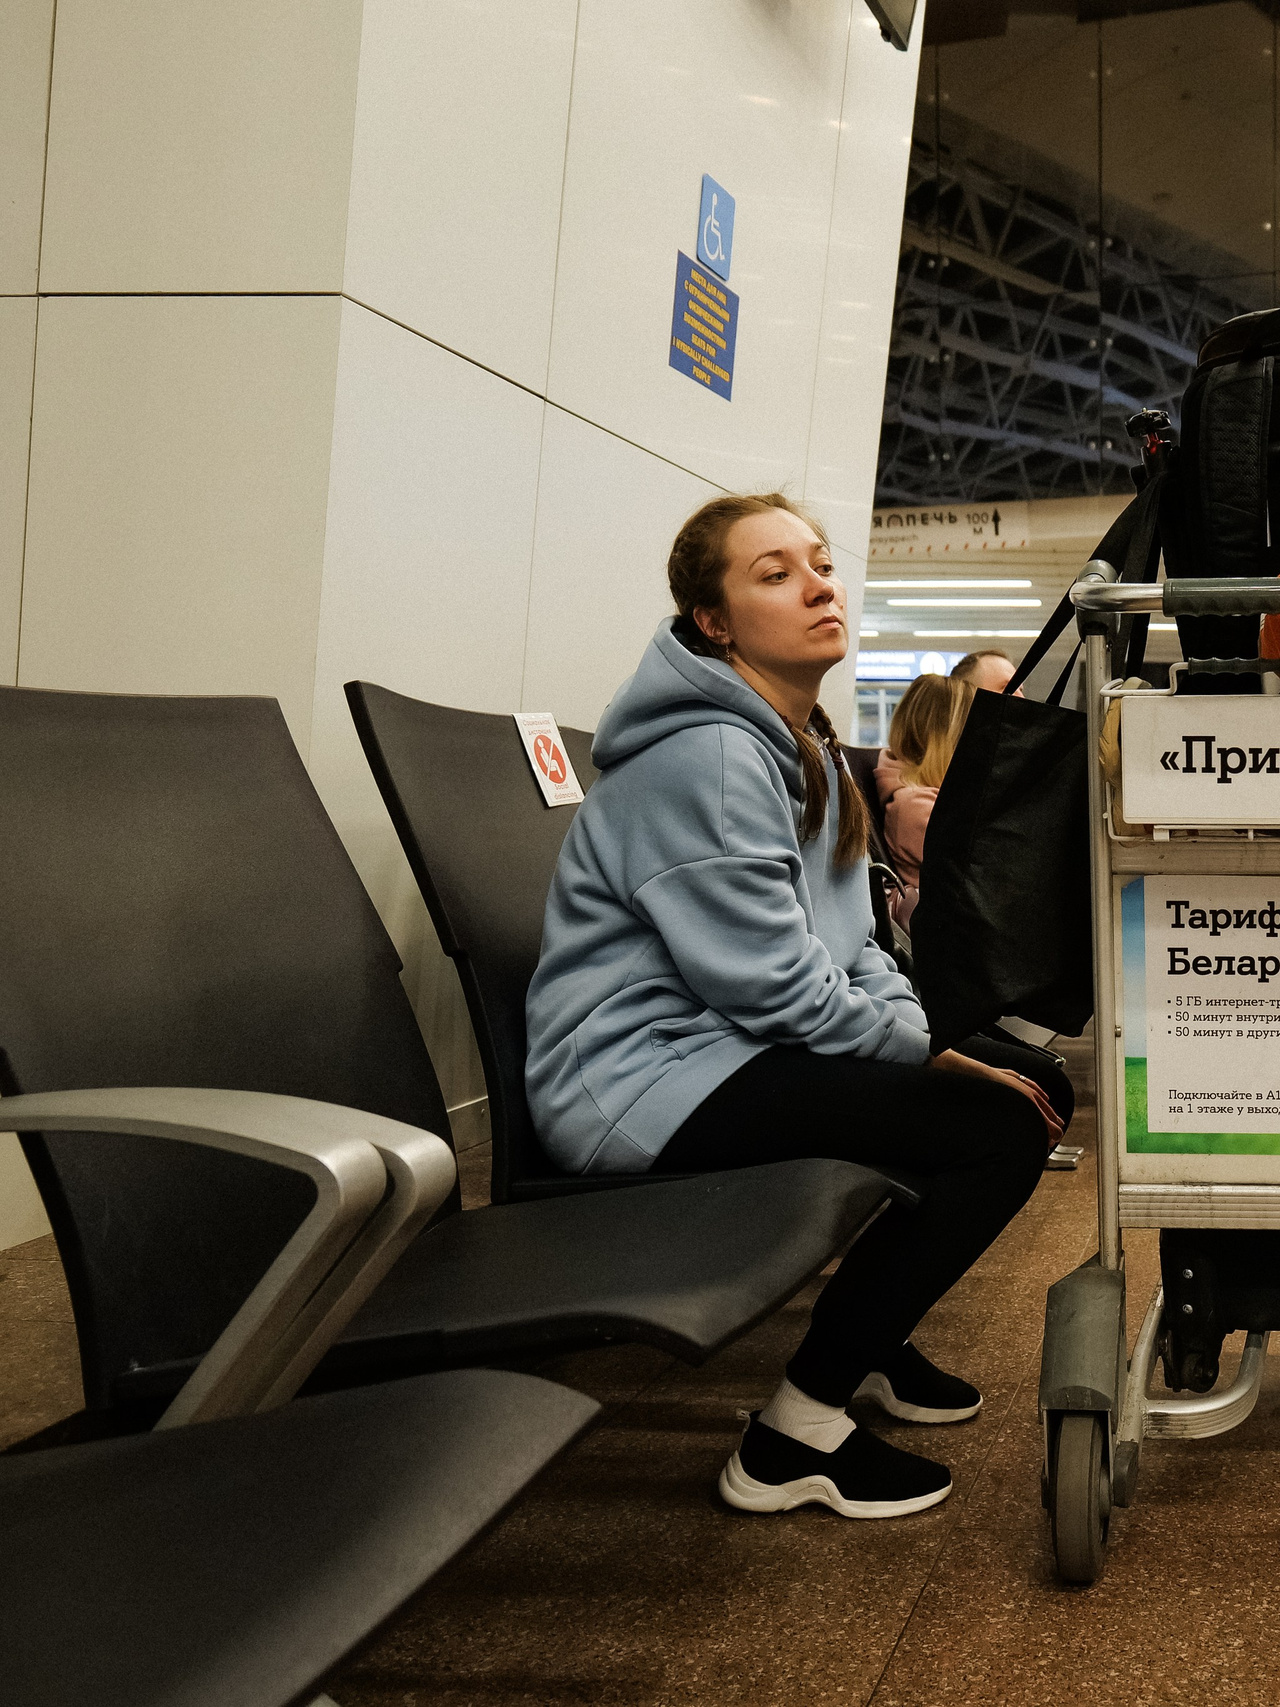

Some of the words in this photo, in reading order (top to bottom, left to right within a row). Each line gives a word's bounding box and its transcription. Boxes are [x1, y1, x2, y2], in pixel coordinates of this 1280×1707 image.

[691, 333, 706, 352] SEATS
[692, 365, 711, 385] PEOPLE
[966, 512, 989, 524] 100
[1175, 996, 1183, 1007] 5
[1186, 996, 1202, 1006] ГБ
[1175, 1012, 1190, 1022] 50
[1193, 1014, 1233, 1024] минут
[1175, 1026, 1190, 1037] 50
[1193, 1029, 1233, 1039] минут
[1236, 1029, 1244, 1037] в
[1168, 1089, 1252, 1101] Подключайте
[1255, 1092, 1263, 1100] в
[1168, 1105, 1184, 1113] на
[1187, 1103, 1193, 1113] 1
[1197, 1105, 1234, 1114] этаже
[1237, 1106, 1244, 1116] у
